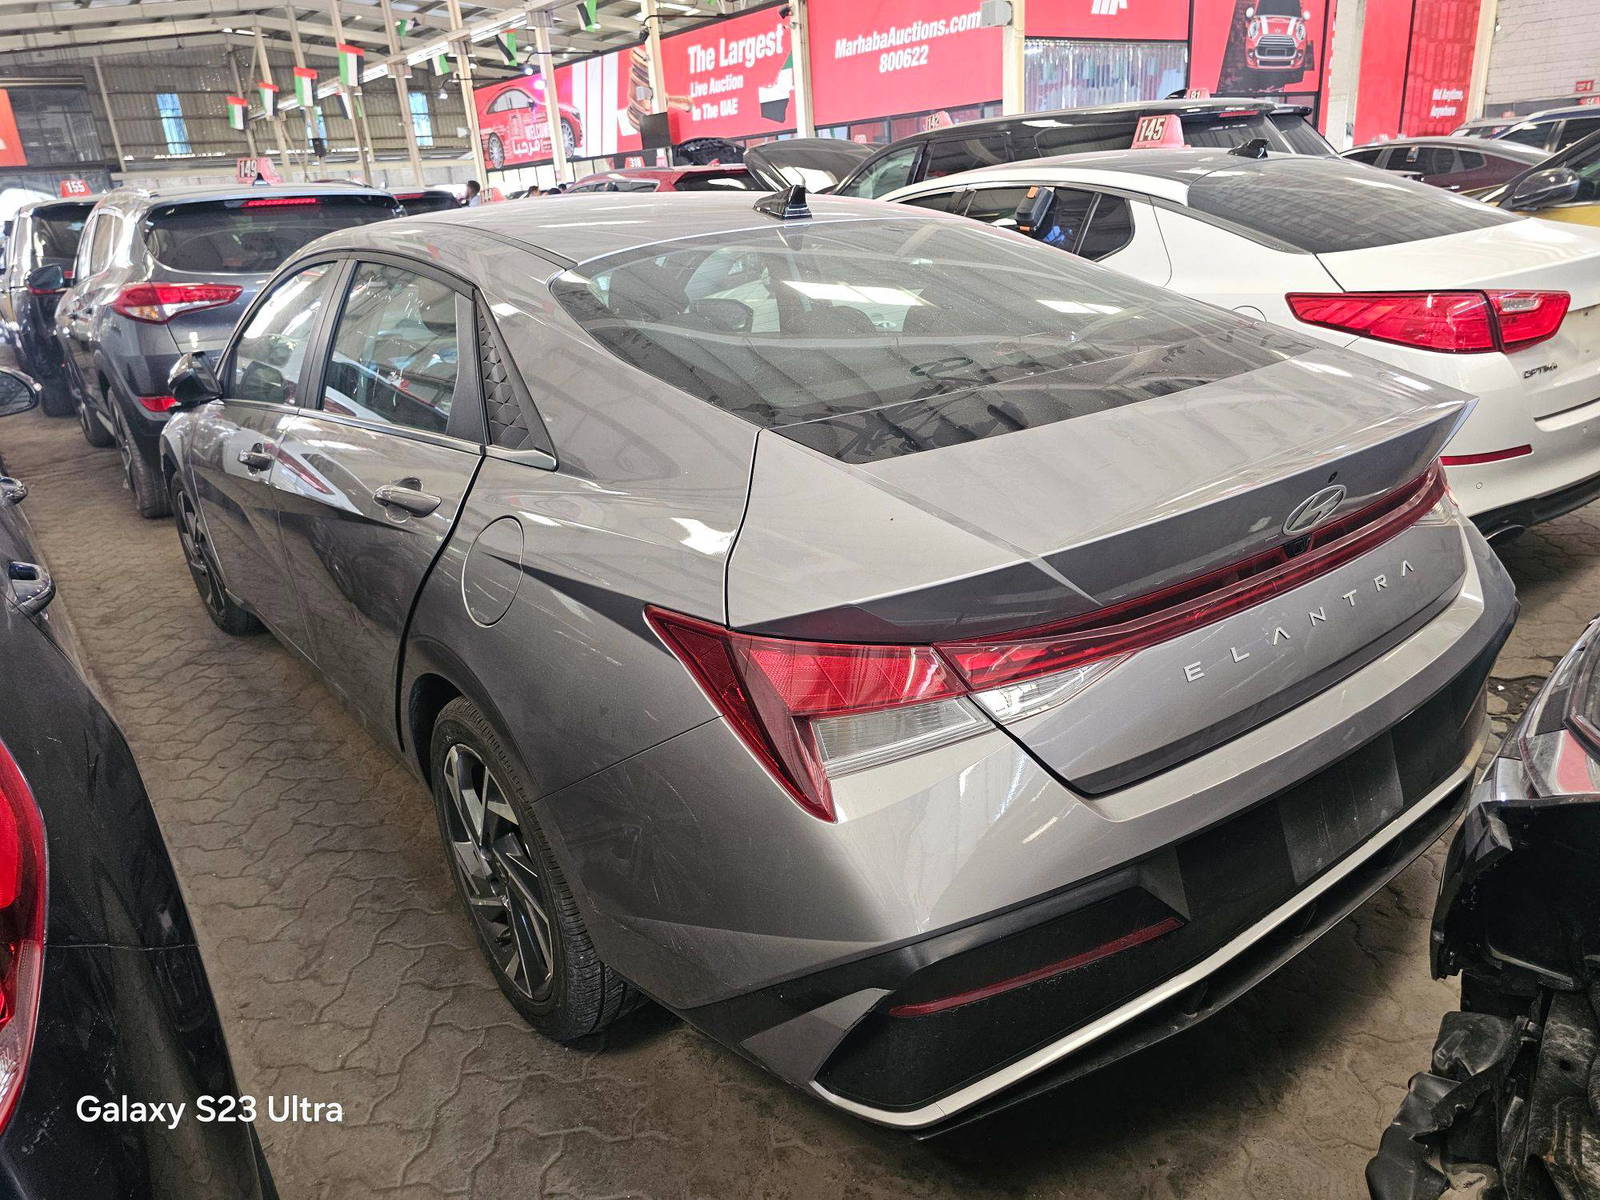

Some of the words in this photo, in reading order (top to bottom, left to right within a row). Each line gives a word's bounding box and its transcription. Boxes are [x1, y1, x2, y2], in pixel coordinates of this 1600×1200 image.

[835, 11, 981, 59] MarhabaAuctions.com
[687, 44, 715, 74] The
[719, 23, 784, 68] Largest
[879, 45, 929, 73] 800622
[690, 81, 708, 98] Live
[709, 73, 744, 94] Auction
[692, 103, 702, 121] In
[702, 103, 719, 120] The
[719, 98, 739, 117] UAE
[1139, 118, 1165, 141] 145
[240, 160, 257, 178] 149
[66, 180, 86, 193] 155
[1183, 559, 1415, 683] ELANTRA
